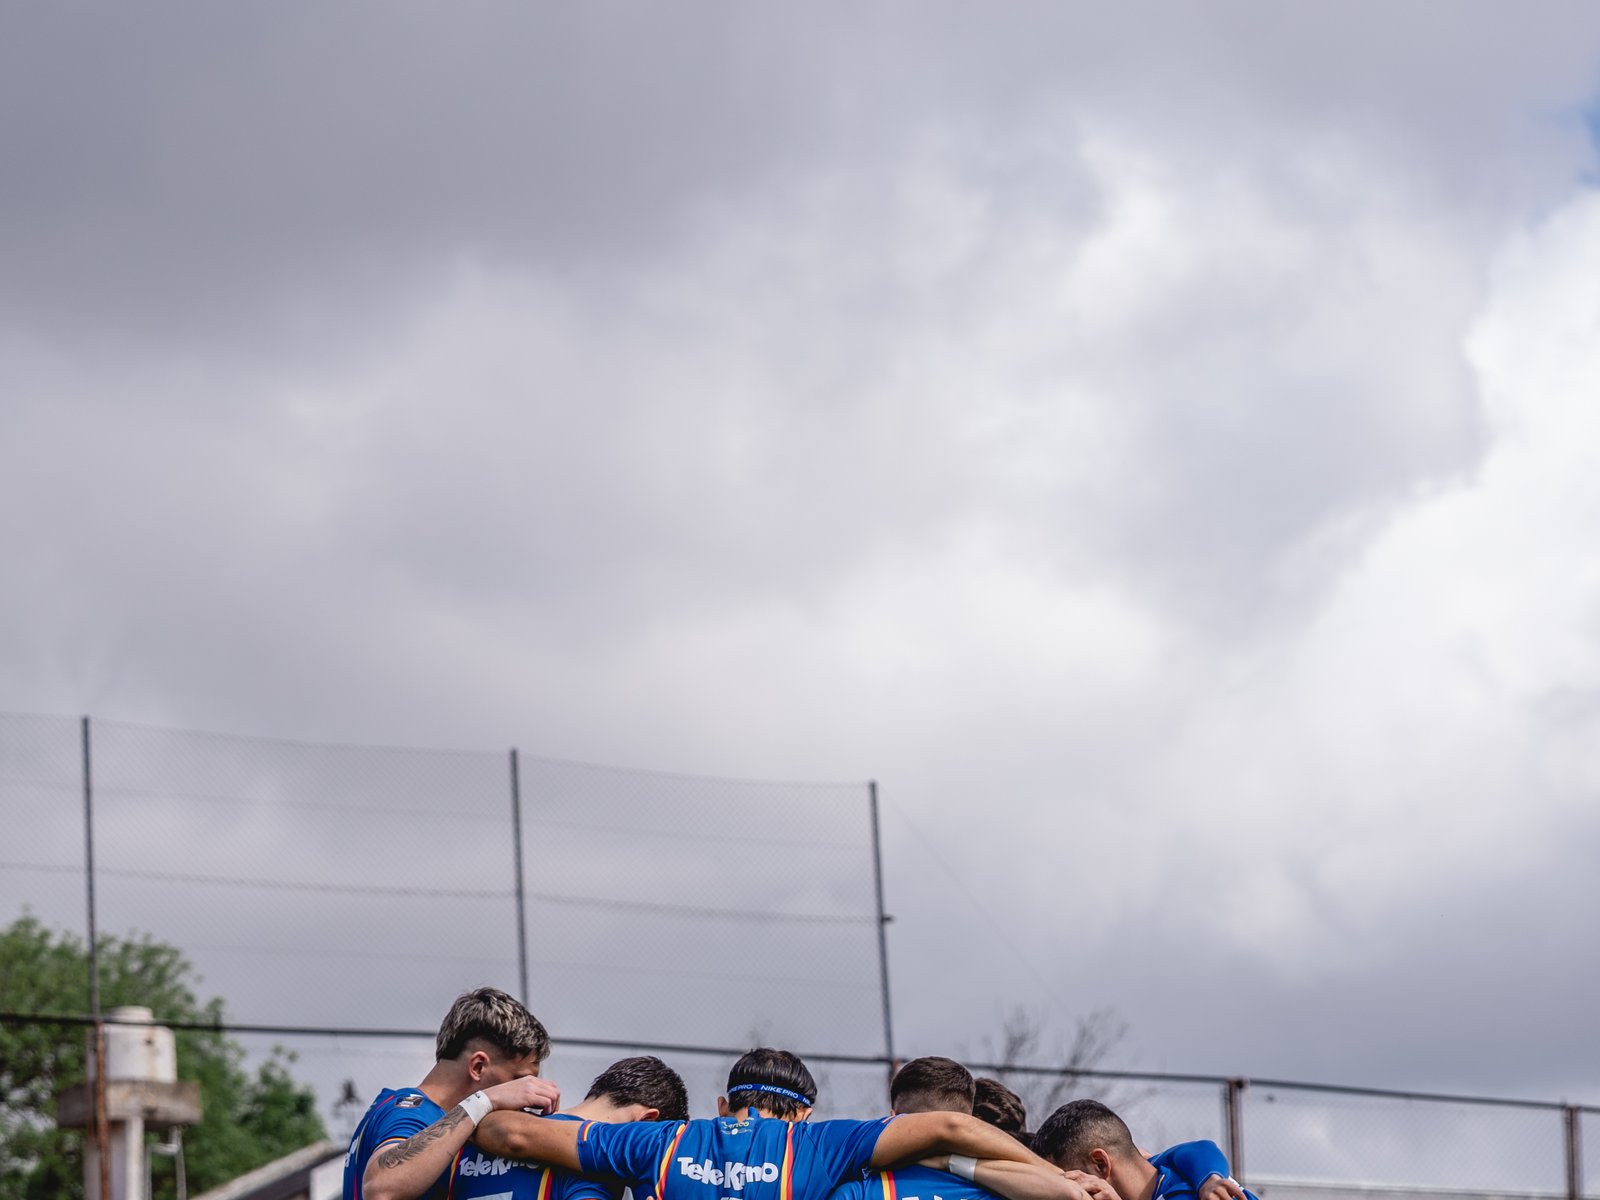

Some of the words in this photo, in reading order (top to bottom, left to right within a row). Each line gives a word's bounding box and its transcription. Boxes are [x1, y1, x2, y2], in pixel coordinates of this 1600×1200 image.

[760, 1085, 782, 1094] NIKE
[782, 1089, 799, 1099] PRO
[459, 1152, 540, 1177] TeleK
[677, 1156, 779, 1191] TeleKino
